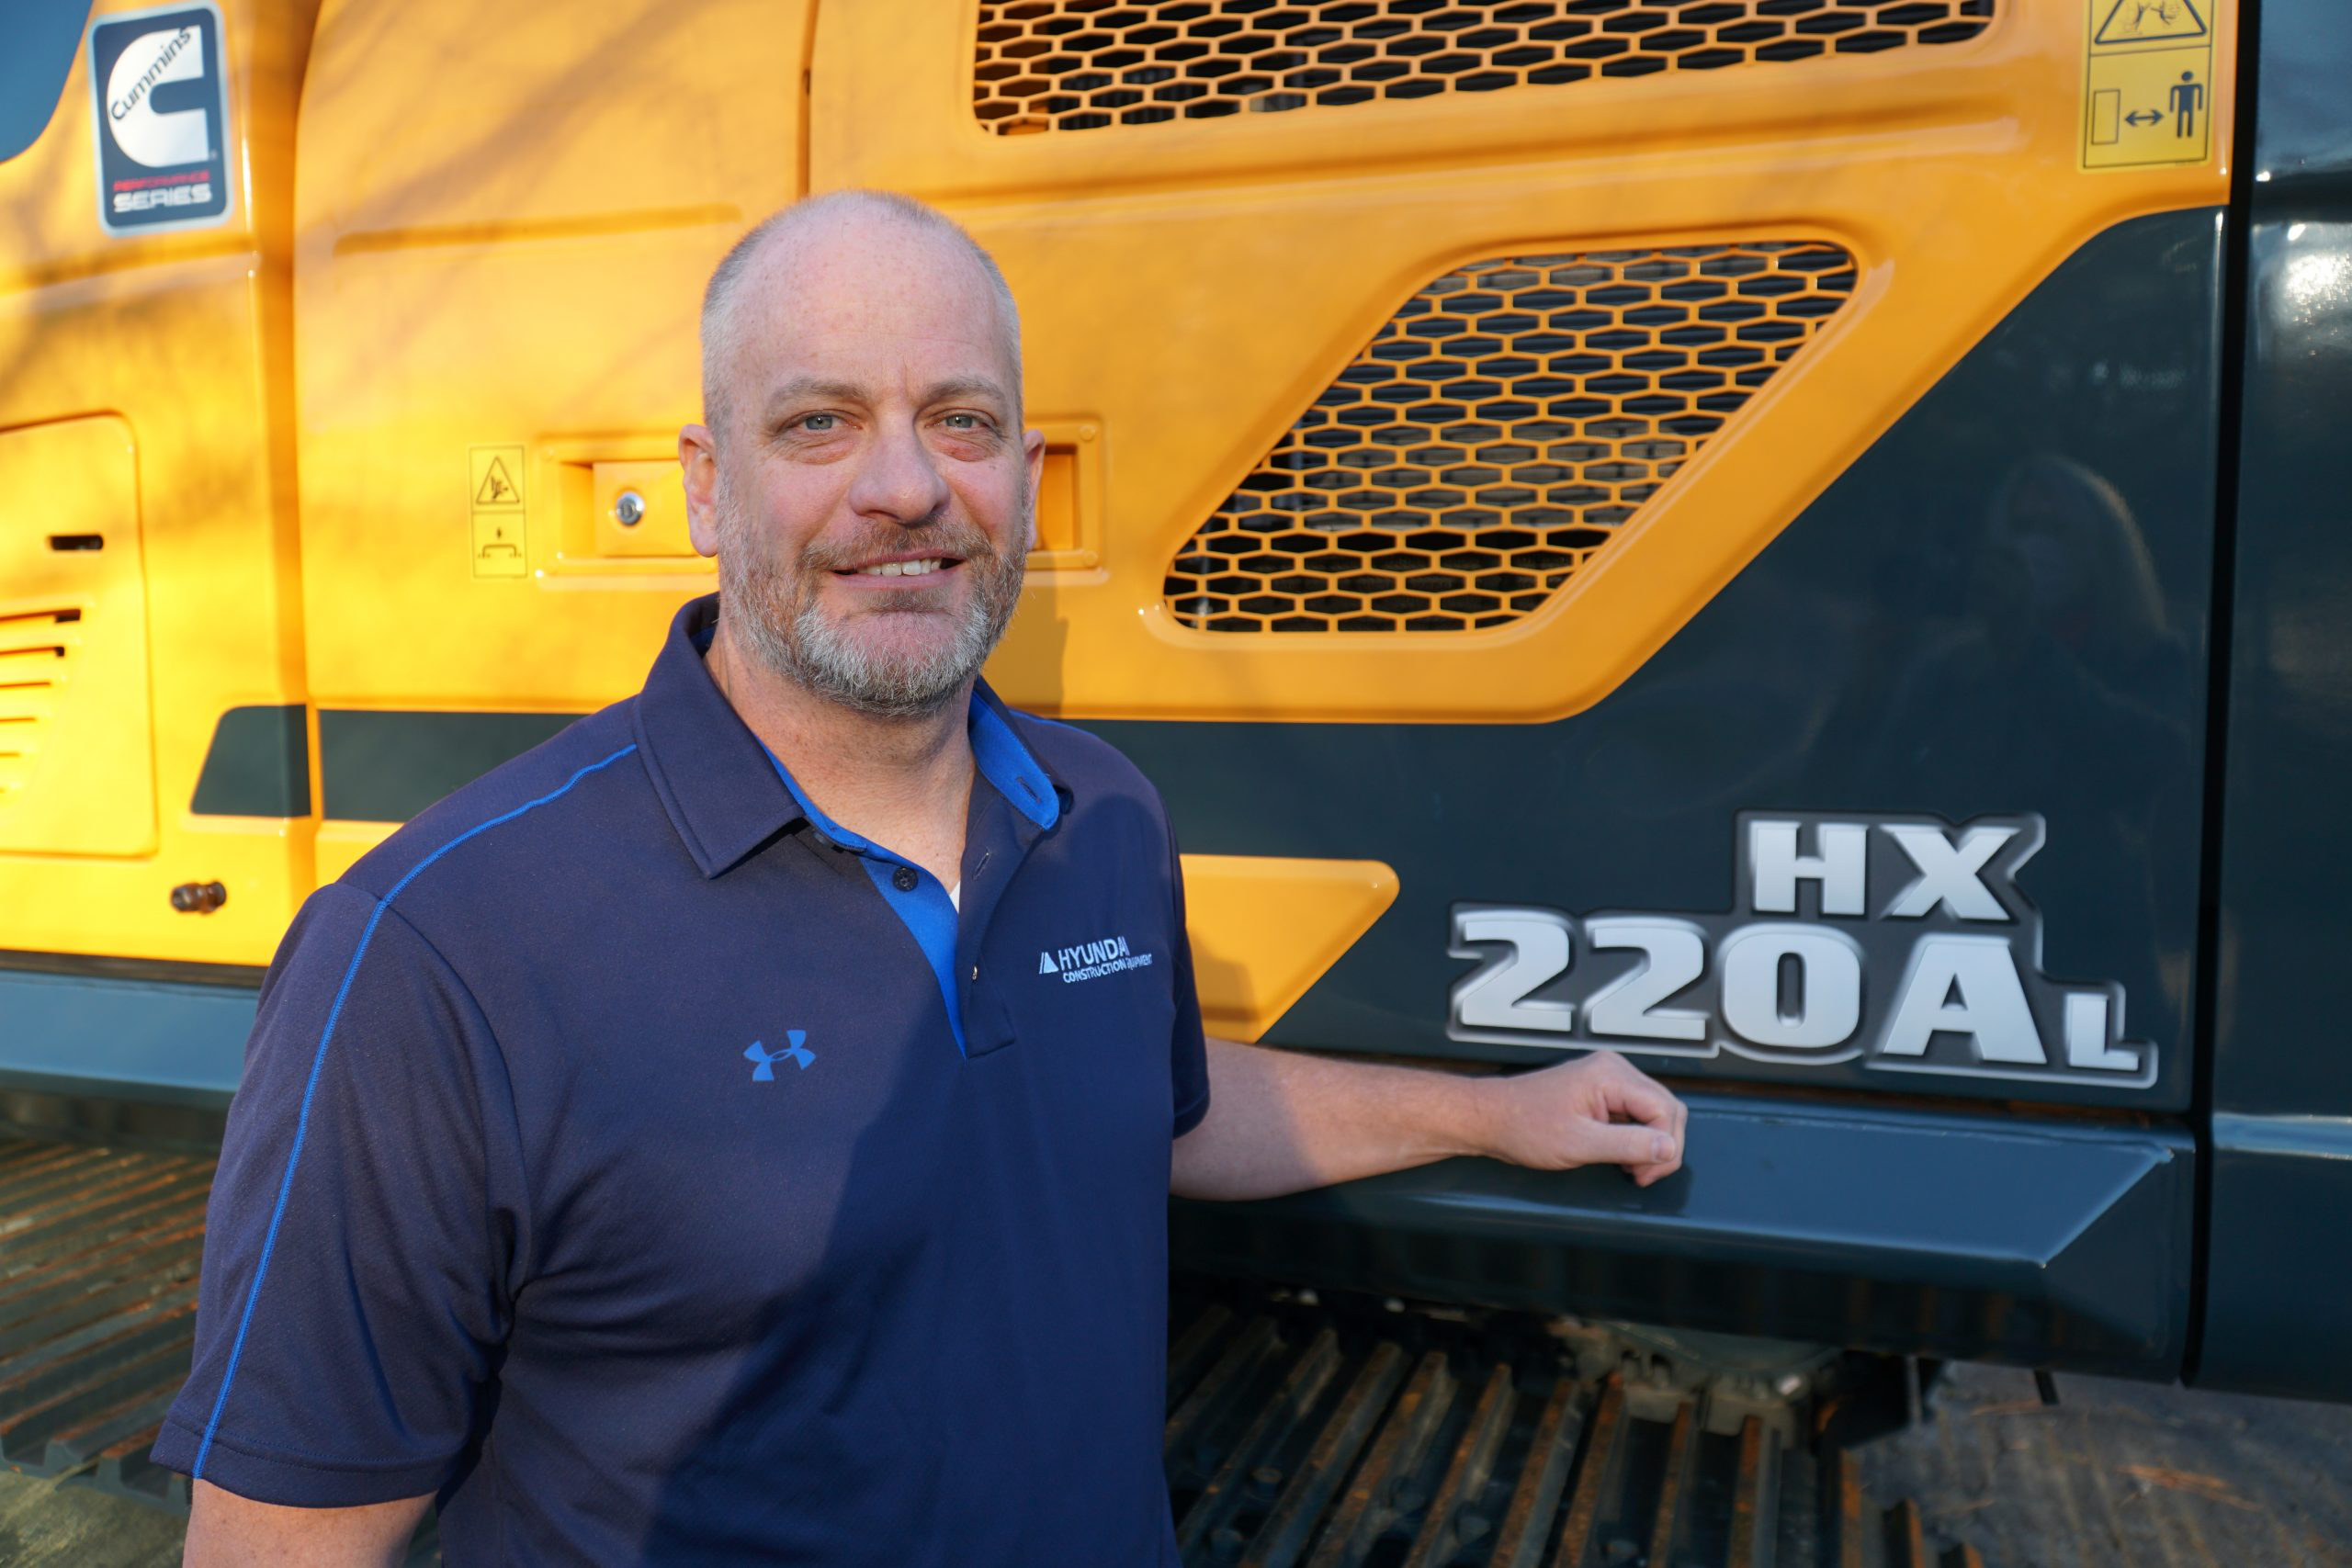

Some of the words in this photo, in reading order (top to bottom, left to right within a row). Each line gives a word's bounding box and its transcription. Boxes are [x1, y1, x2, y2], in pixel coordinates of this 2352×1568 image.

[110, 28, 192, 121] Cummins
[113, 183, 212, 213] SERIES
[1748, 819, 2021, 919] HX
[1062, 957, 1127, 984] CONSTRUCTION
